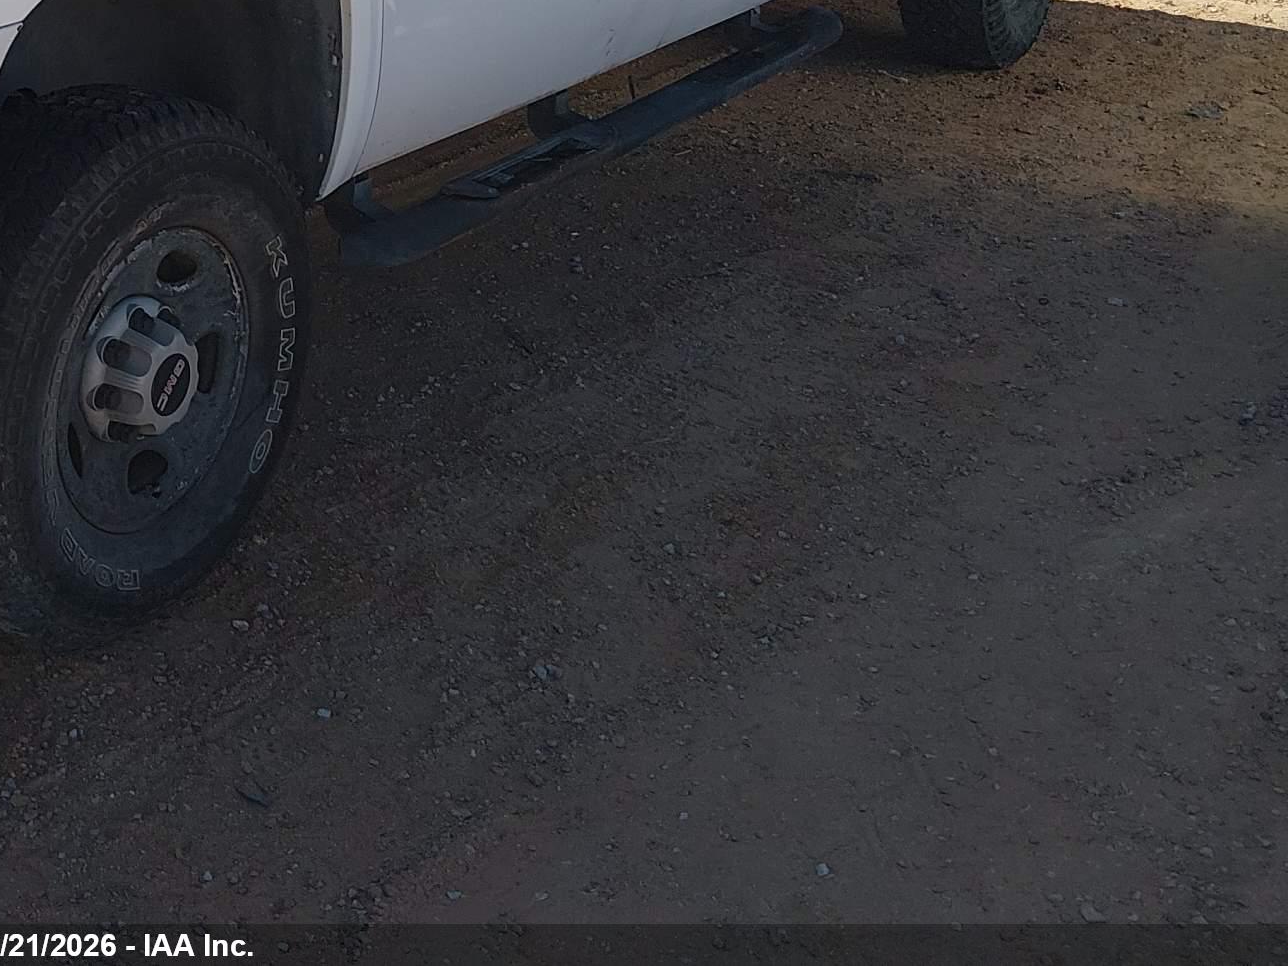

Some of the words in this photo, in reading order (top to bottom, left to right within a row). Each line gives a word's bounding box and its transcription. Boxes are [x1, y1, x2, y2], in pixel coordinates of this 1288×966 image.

[157, 359, 185, 412] GMC
[250, 234, 298, 475] KUMHO
[59, 527, 141, 592] ROAD
